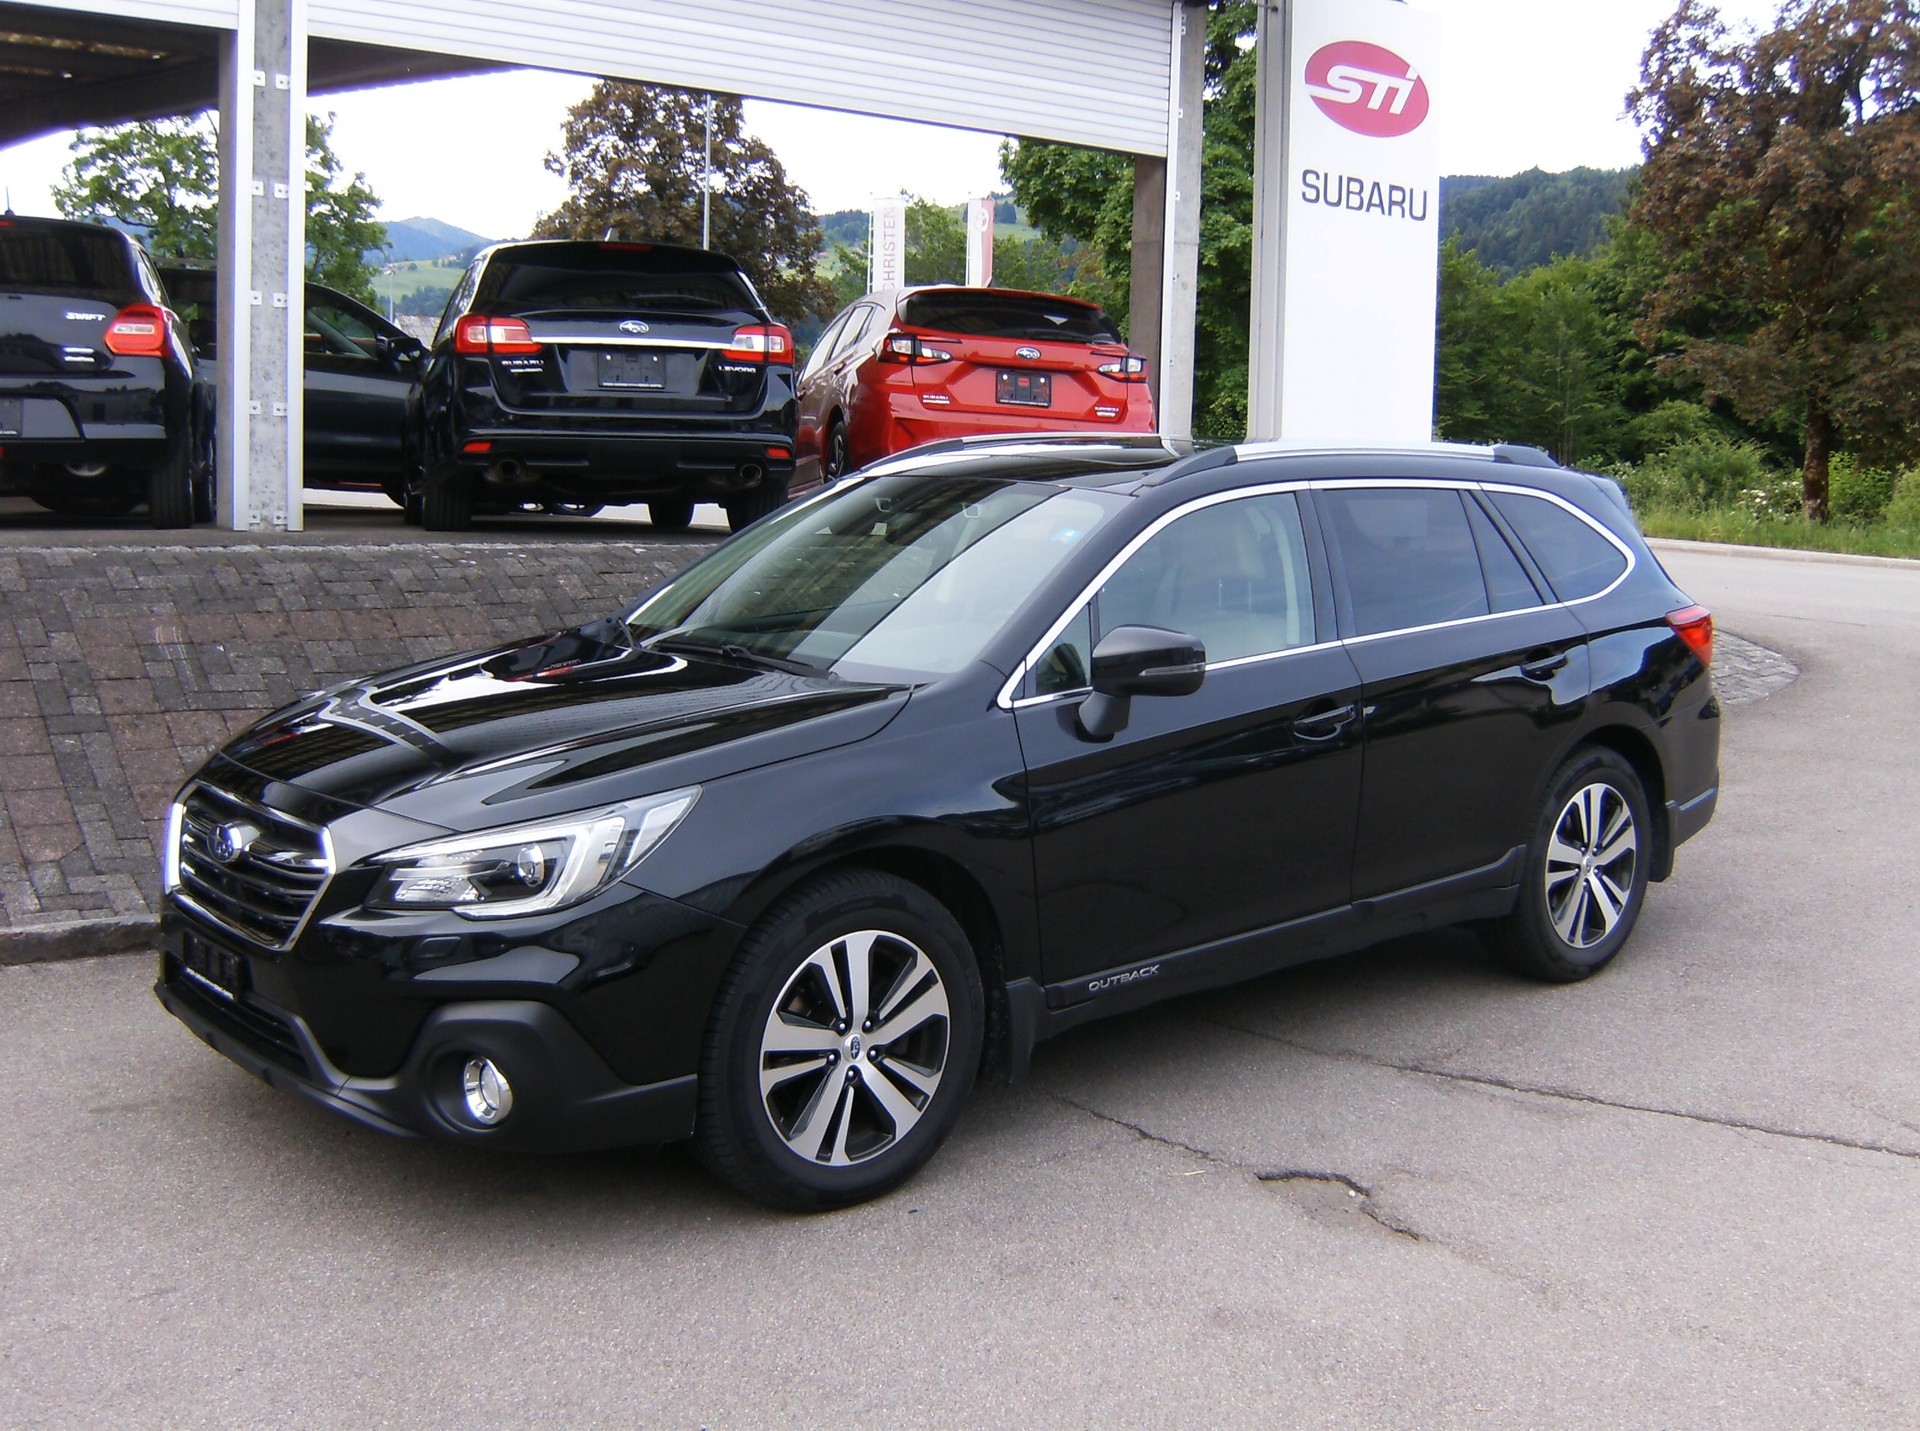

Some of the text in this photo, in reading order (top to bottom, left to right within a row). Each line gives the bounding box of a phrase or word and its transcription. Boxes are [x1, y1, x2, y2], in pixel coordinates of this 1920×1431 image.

[1301, 169, 1428, 222] SUBARU
[65, 311, 106, 321] SWIFT
[718, 365, 757, 374] LEVORG
[1088, 964, 1160, 991] OUTBACK
